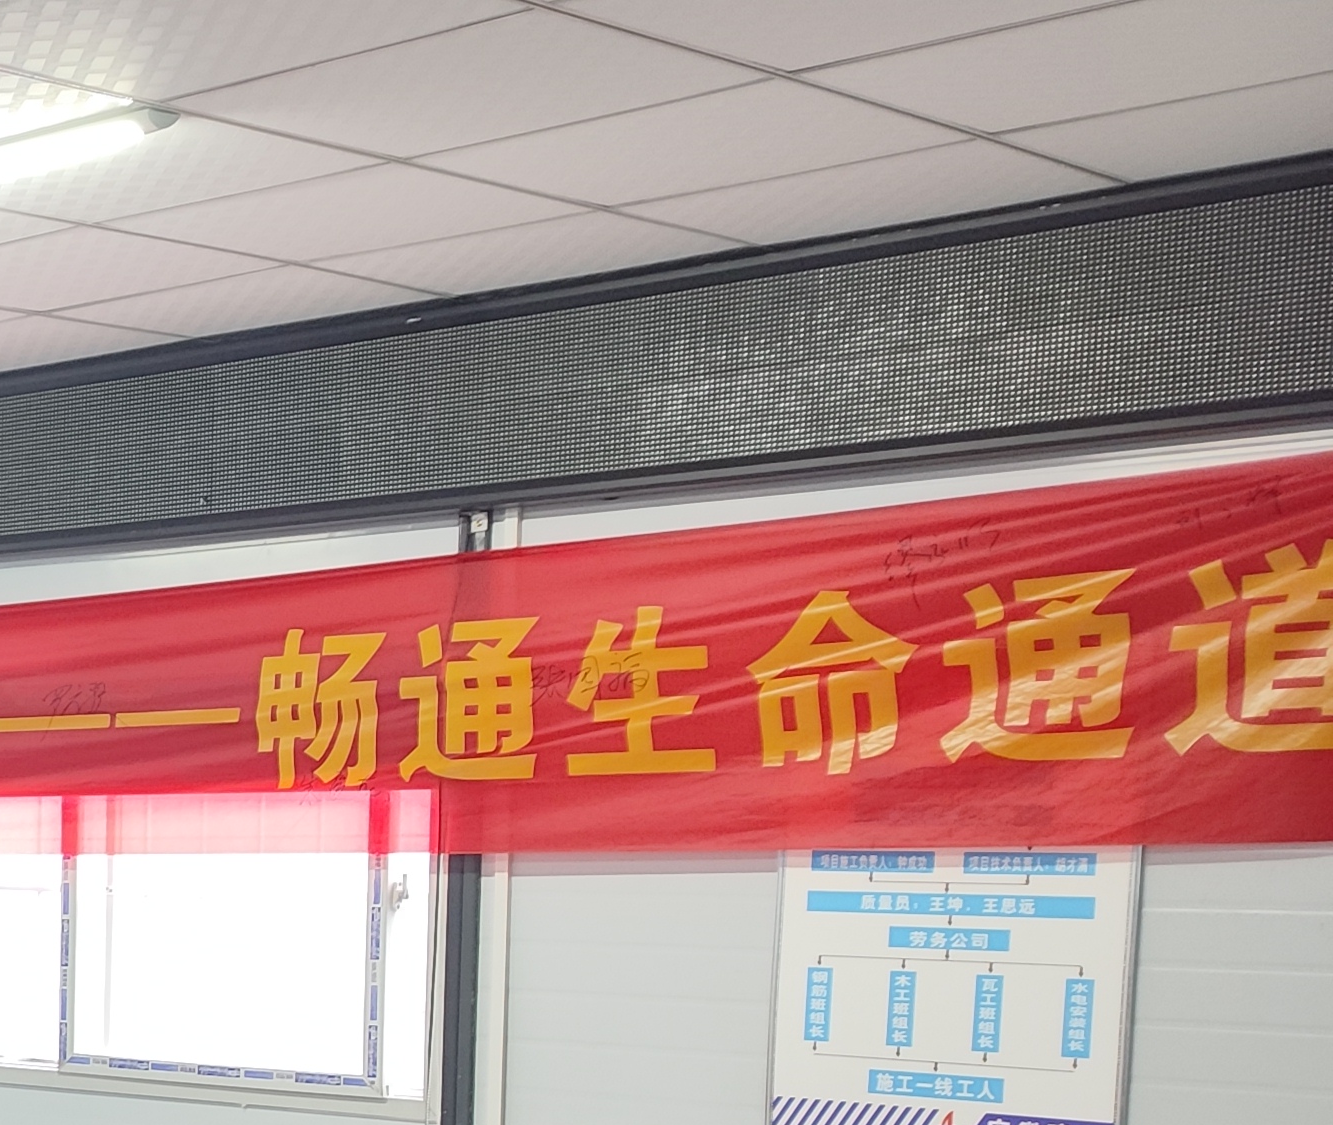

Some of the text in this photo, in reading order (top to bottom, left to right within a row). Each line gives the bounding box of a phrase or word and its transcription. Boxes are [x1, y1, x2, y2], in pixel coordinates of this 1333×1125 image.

[909, 931, 989, 949] 劳务公司
[809, 970, 829, 1038] 钢筋班组长
[891, 974, 912, 1044] 木工班组长
[977, 978, 999, 1049] 瓦工班组长
[1067, 982, 1089, 1052] 水电安装组长
[875, 1073, 996, 1101] 施工一线工人
